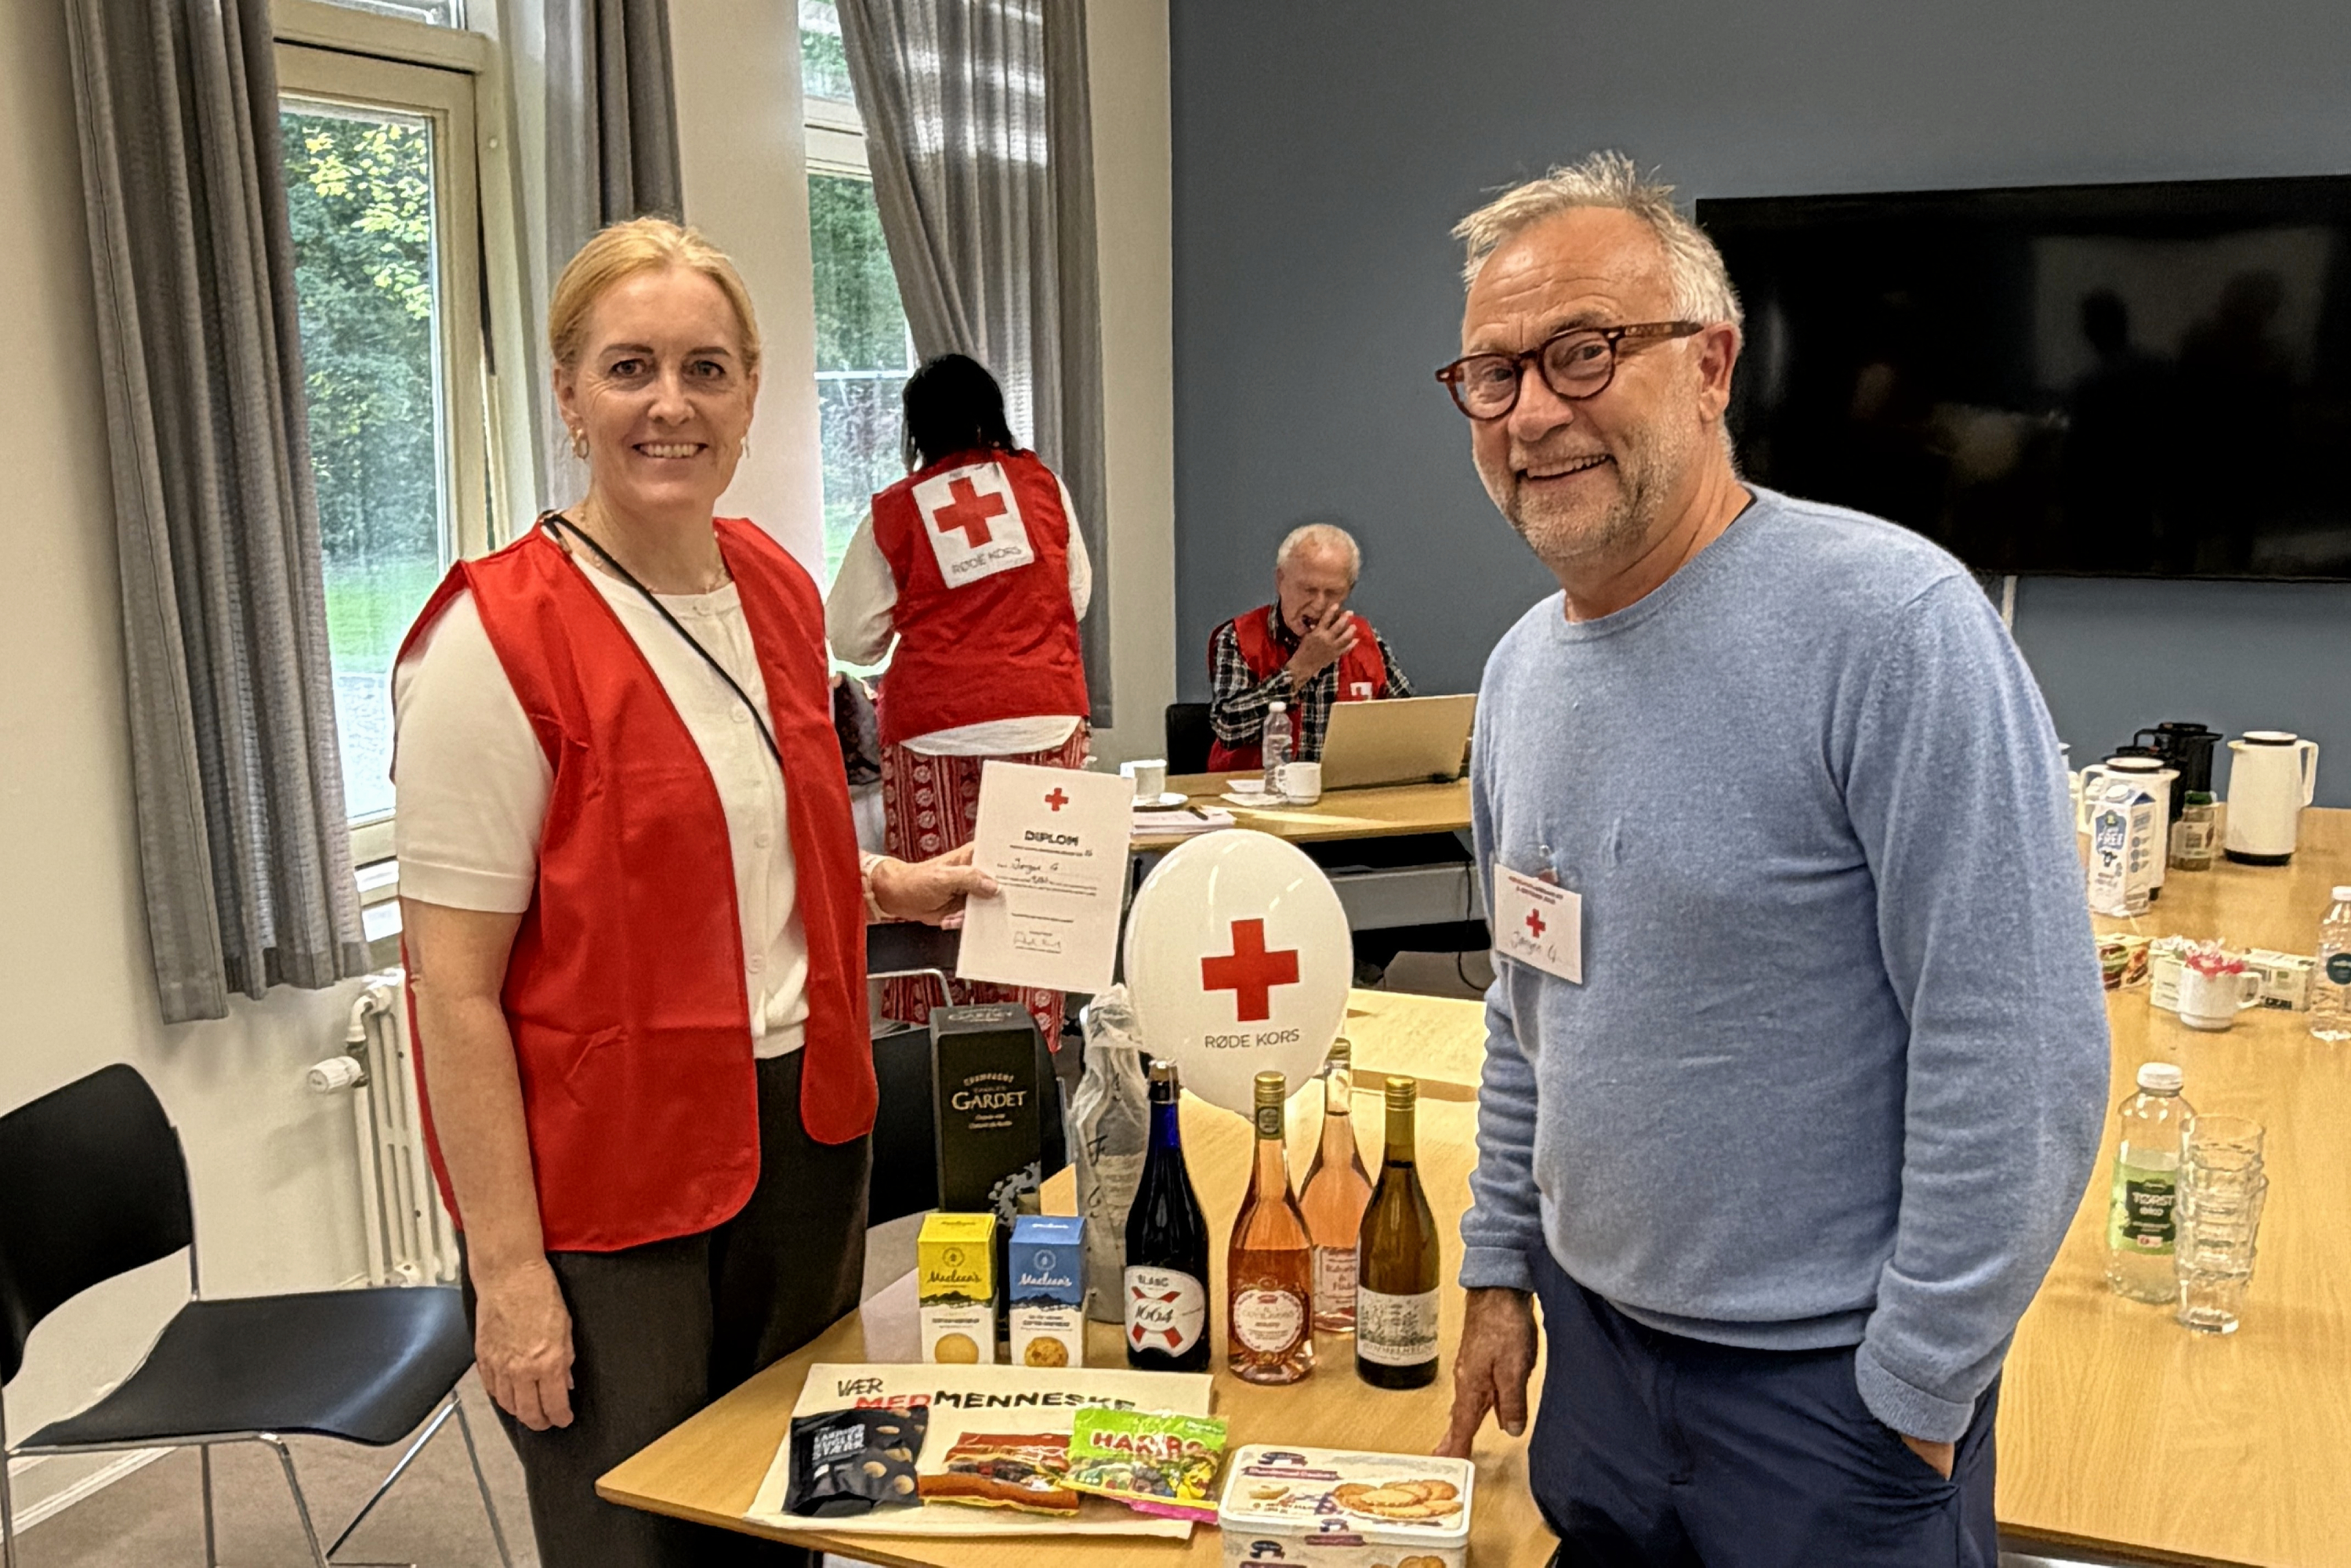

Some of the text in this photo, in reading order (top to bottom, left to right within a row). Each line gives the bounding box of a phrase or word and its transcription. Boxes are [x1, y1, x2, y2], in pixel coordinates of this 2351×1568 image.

[1024, 830, 1079, 846] DIPLOM
[1204, 1028, 1300, 1049] RØDE KORS
[951, 1090, 1027, 1111] GARDET
[1135, 1304, 1174, 1324] 1664
[837, 1377, 884, 1397] VÆR
